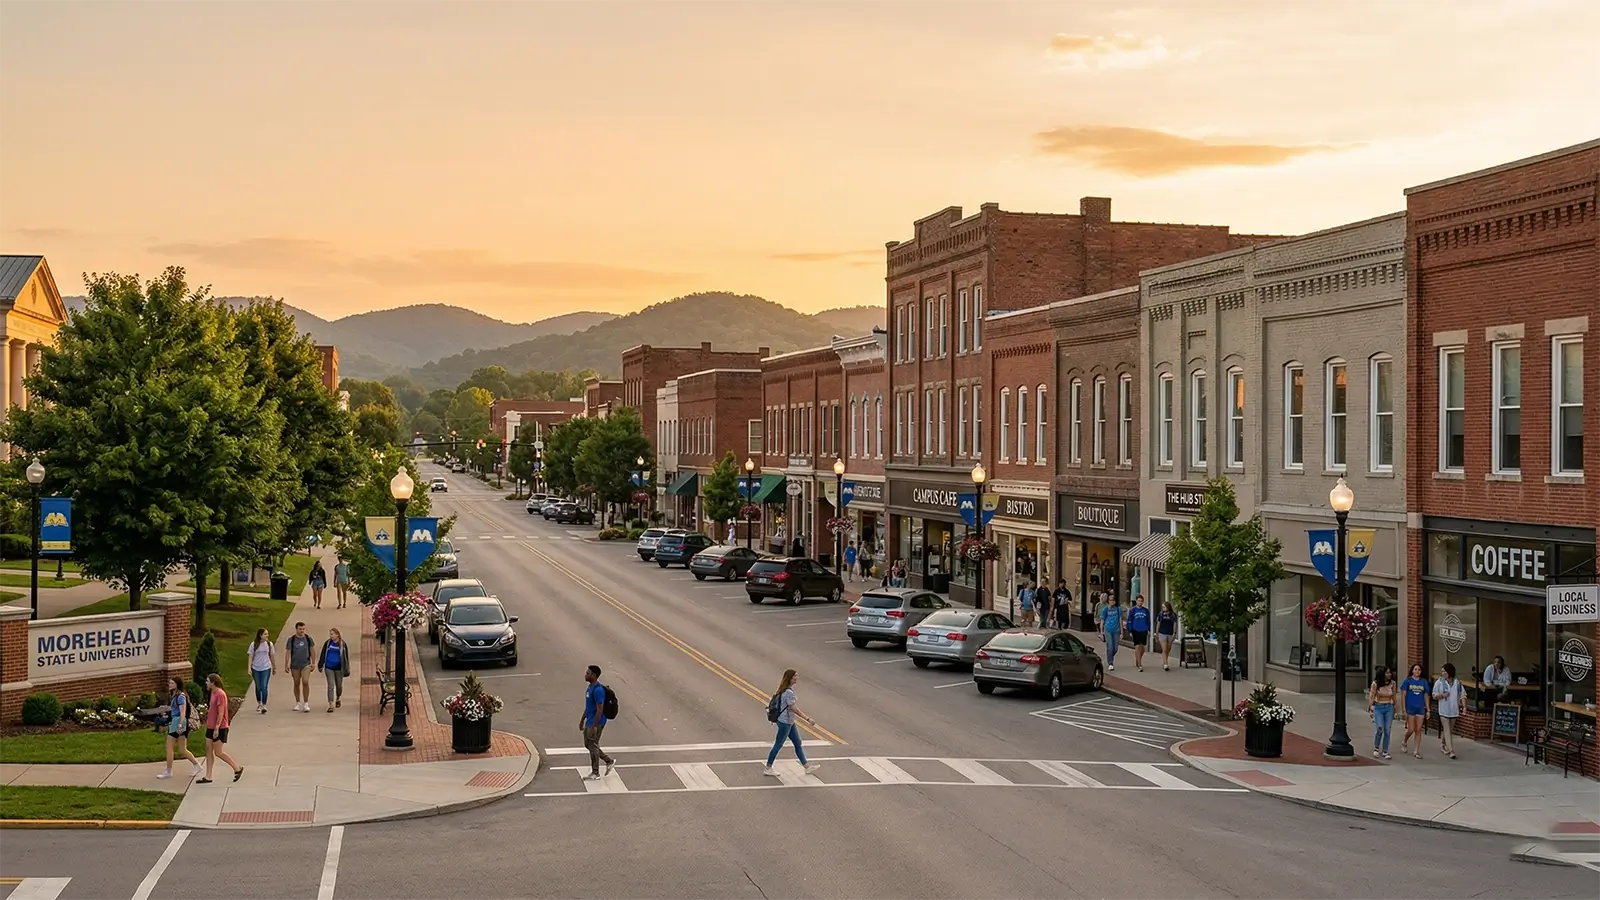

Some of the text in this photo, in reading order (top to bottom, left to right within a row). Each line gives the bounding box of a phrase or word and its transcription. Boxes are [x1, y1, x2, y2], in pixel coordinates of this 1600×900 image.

[913, 488, 958, 507] CAMPUS CAFE
[1167, 492, 1209, 505] THE HUB STU
[1006, 500, 1034, 516] BISTRO
[1078, 506, 1119, 526] BOUTIQUE
[1471, 543, 1546, 582] COFFEE
[1559, 591, 1588, 603] LOCAL
[1551, 603, 1596, 616] BUSINESS
[37, 627, 150, 654] MOREHEAD
[37, 645, 151, 668] STATE UNIVERSITY
